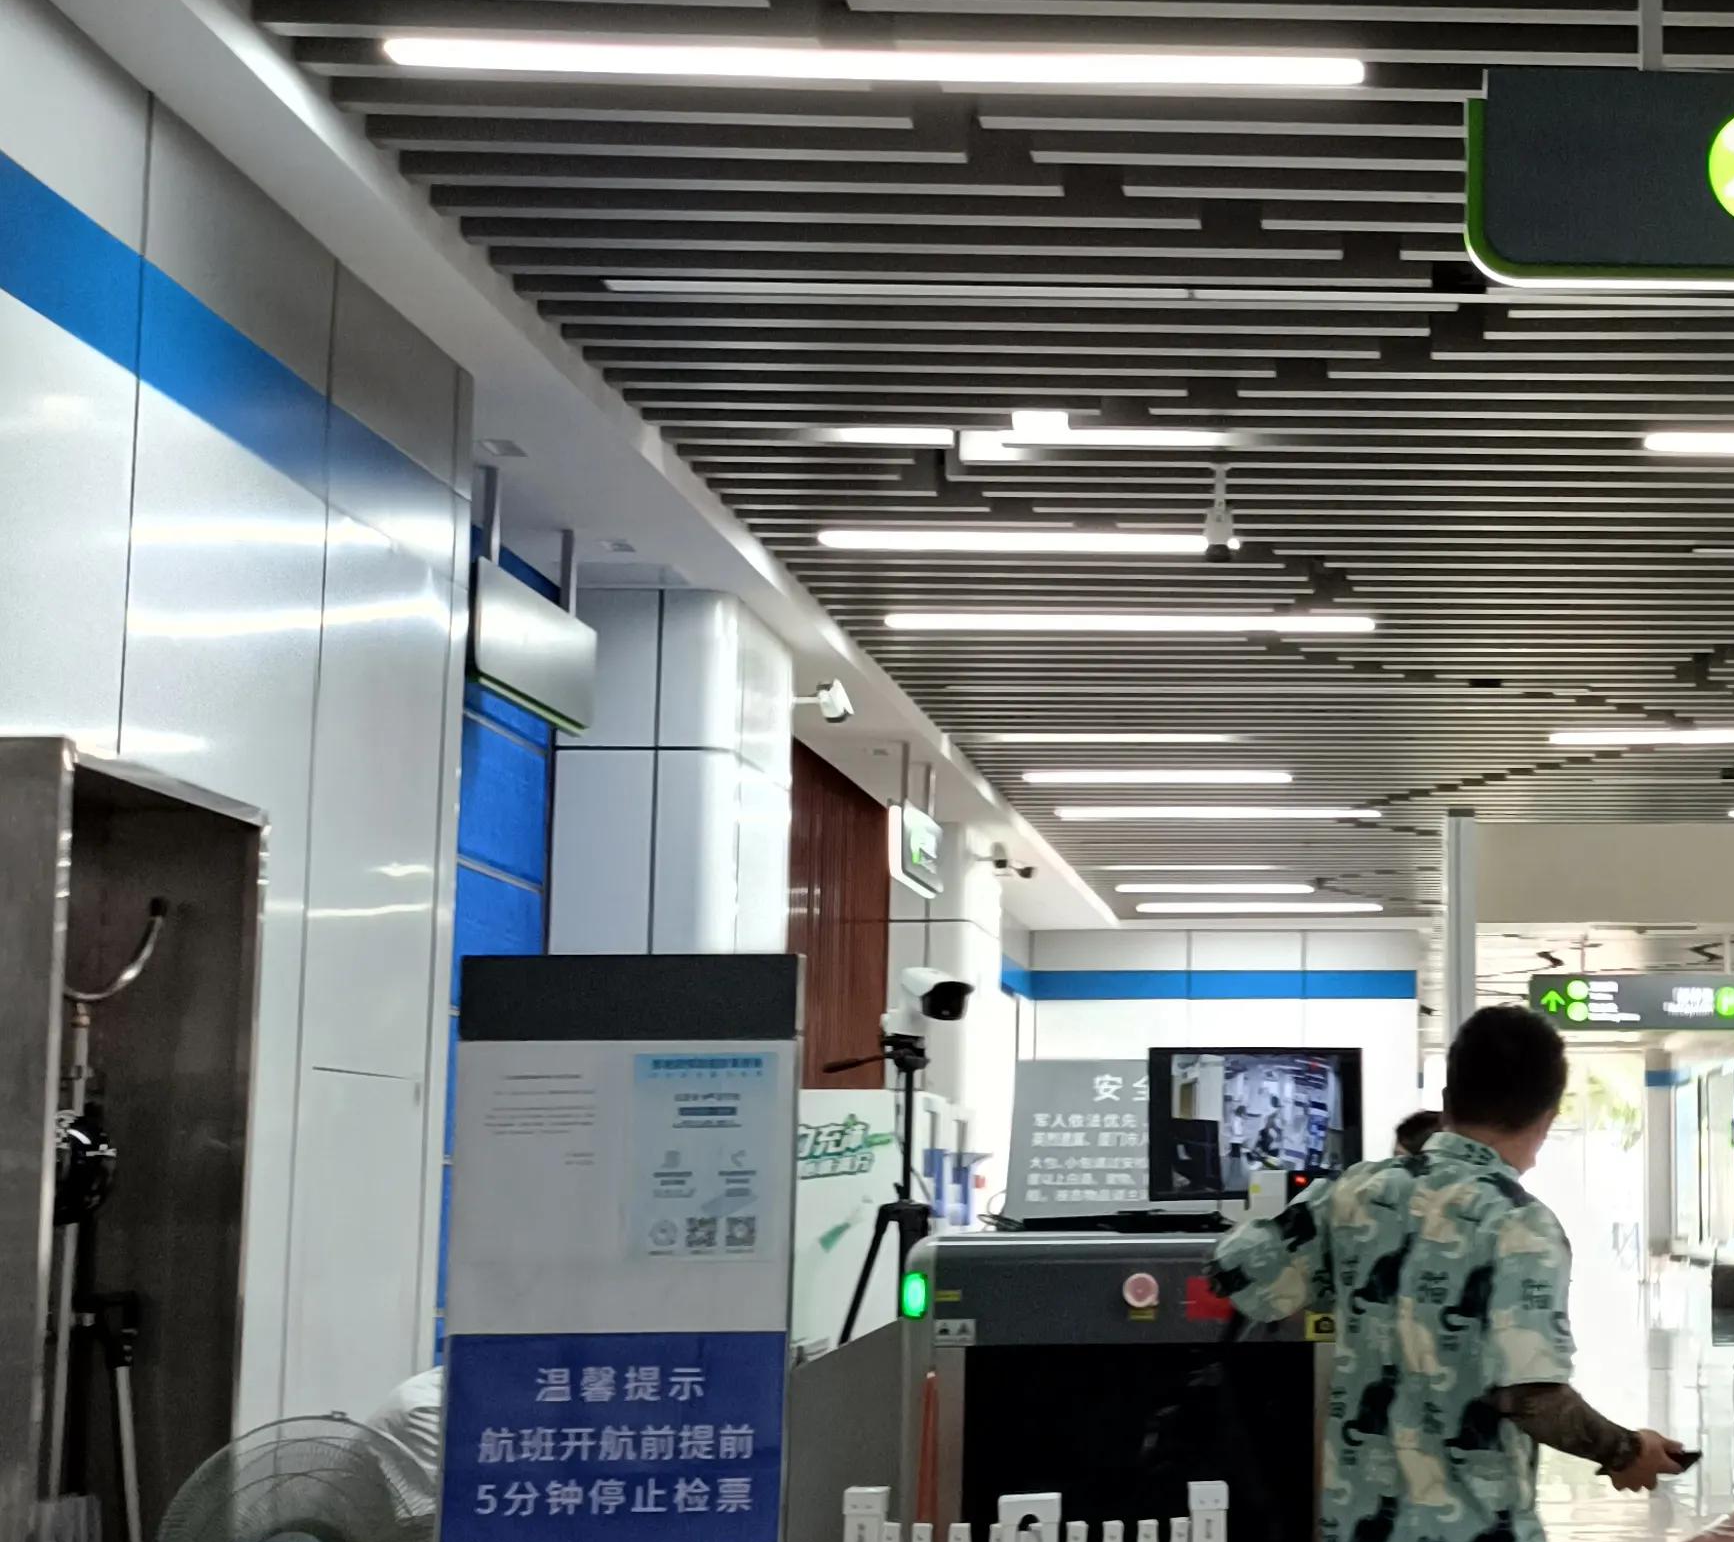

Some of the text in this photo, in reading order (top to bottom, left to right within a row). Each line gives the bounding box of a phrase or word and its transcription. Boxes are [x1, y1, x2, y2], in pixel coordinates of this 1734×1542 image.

[535, 1366, 704, 1402] 温馨提示
[478, 1424, 755, 1463] 航班开航前提前
[474, 1477, 752, 1516] 5分钟停止检票
